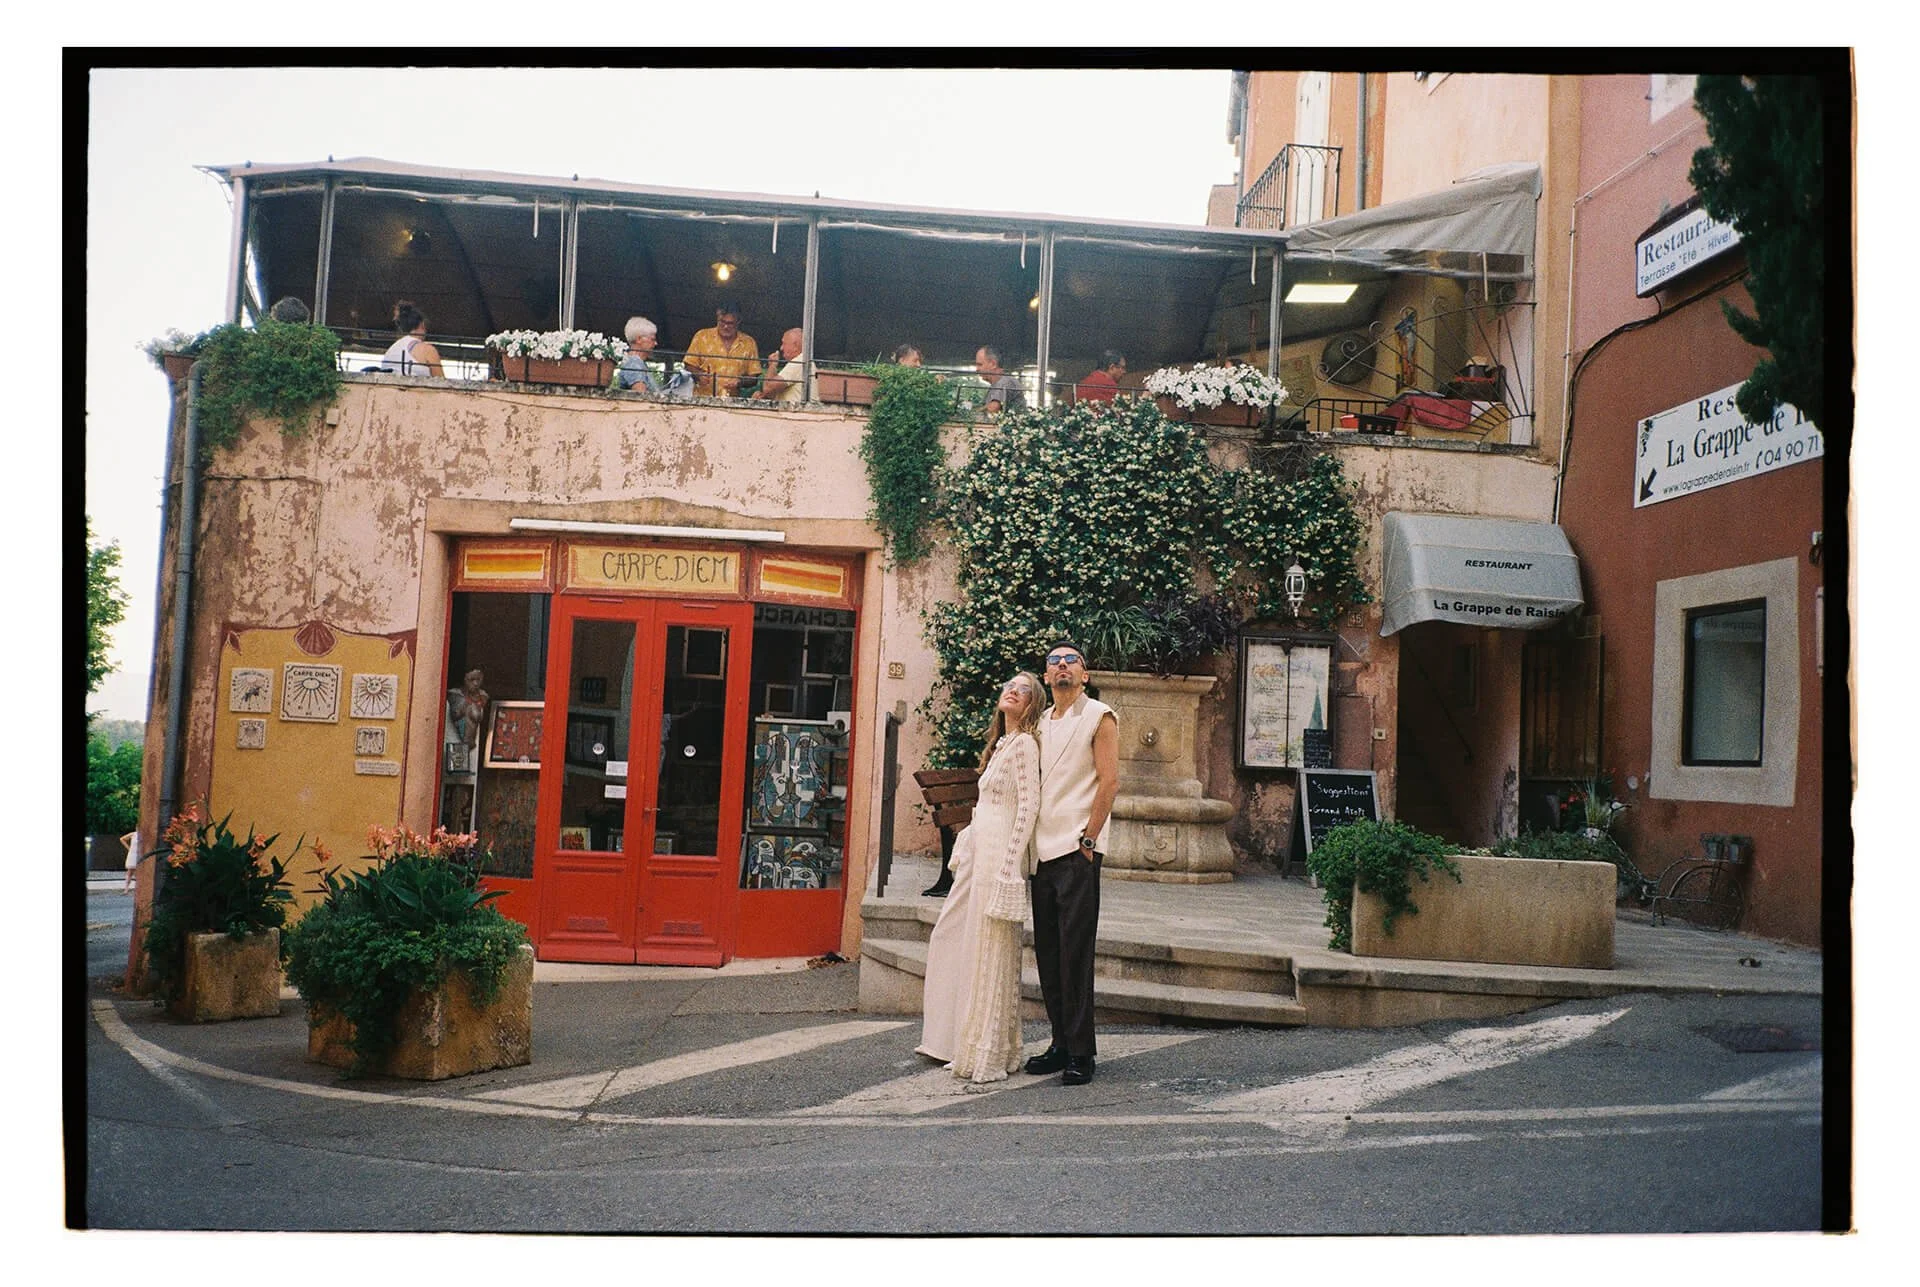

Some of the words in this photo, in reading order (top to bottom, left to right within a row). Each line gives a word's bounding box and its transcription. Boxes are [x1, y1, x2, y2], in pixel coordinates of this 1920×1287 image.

[1640, 261, 1676, 288] Terrasse
[1666, 439, 1685, 468] La
[1693, 422, 1754, 460] Grappe
[1764, 447, 1782, 467] 04
[1786, 440, 1805, 460] 90
[1808, 434, 1819, 453] 71
[1464, 559, 1533, 571] RESTAURANT
[1433, 599, 1449, 612] La
[1453, 601, 1501, 617] Grappe
[1505, 604, 1522, 617] de
[1526, 606, 1566, 619] Raisin
[890, 663, 903, 675] 39
